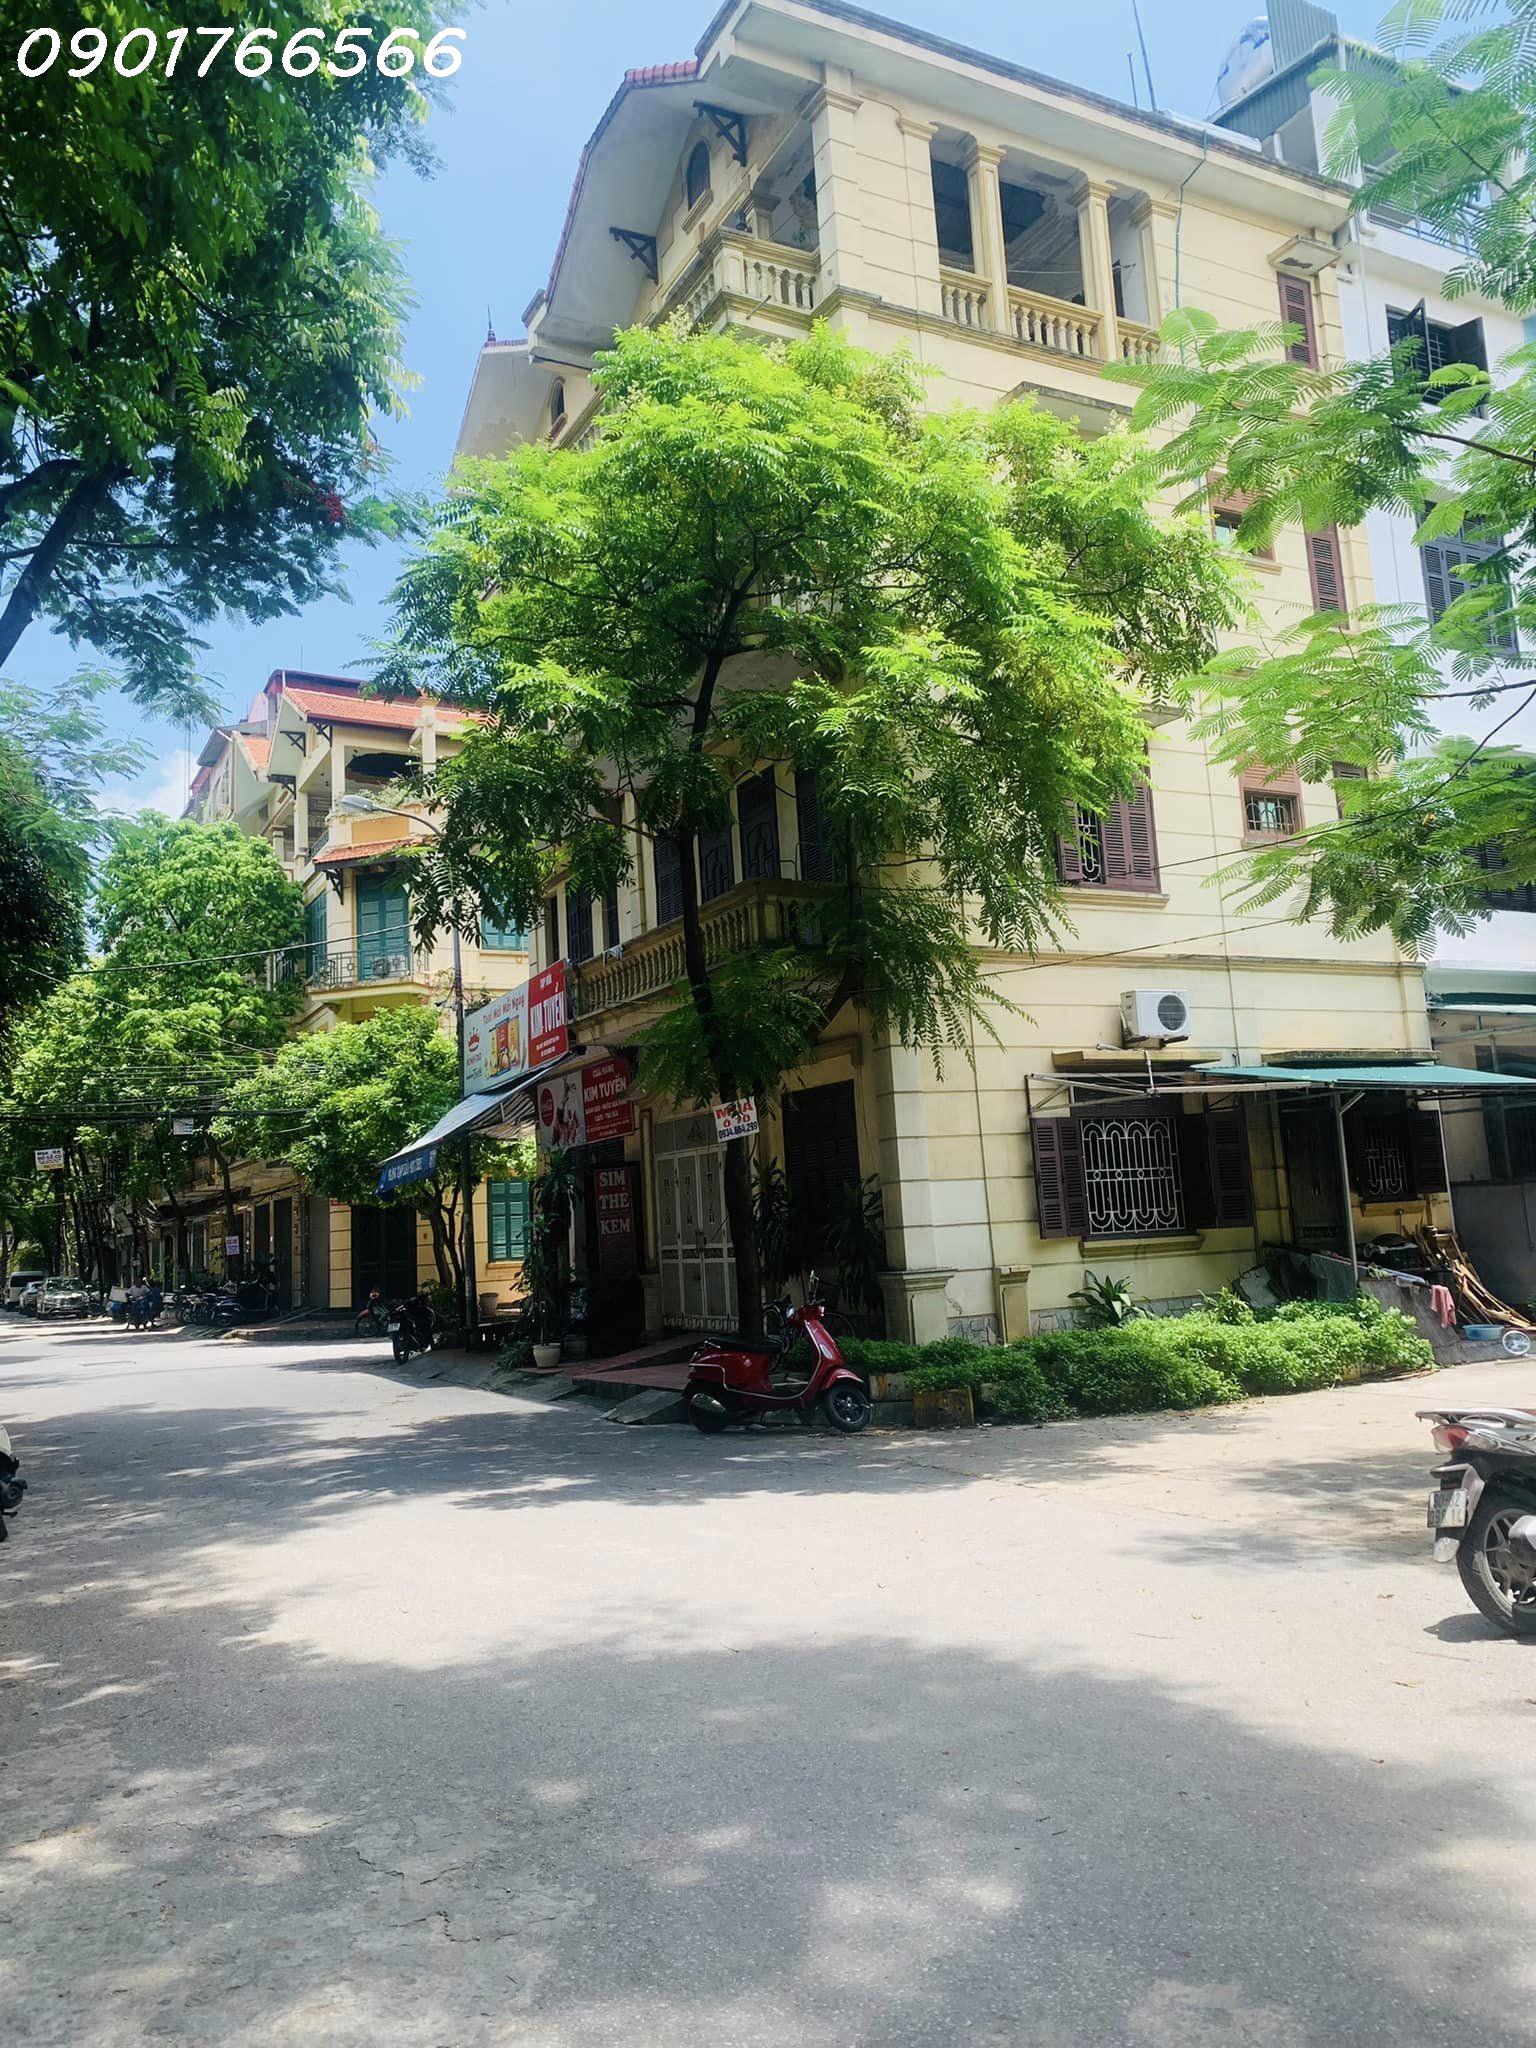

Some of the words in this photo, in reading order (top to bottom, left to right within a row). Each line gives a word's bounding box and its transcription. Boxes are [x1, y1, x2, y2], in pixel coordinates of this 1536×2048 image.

[584, 1085, 599, 1102] KIM
[600, 1170, 625, 1187] SIM
[600, 1218, 631, 1235] KEM
